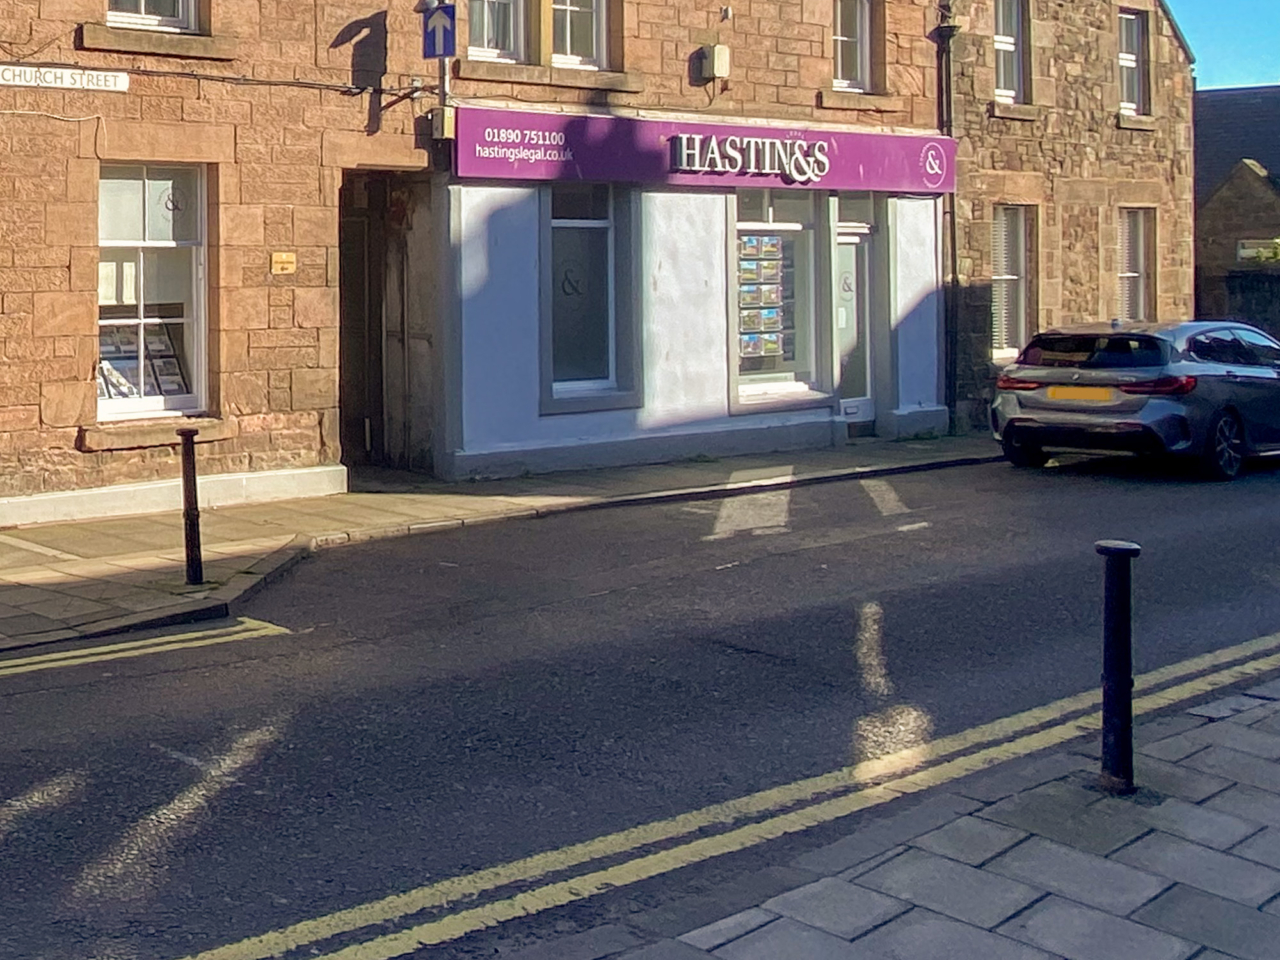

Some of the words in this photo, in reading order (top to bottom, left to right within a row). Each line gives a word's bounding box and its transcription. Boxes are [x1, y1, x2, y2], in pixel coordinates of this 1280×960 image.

[1, 68, 64, 85] CHURCH
[70, 72, 119, 88] STREET
[484, 128, 521, 143] 01890
[523, 130, 565, 145] 751100
[475, 143, 573, 163] hastingslegal.co.uk
[678, 133, 830, 182] HASTIN&S
